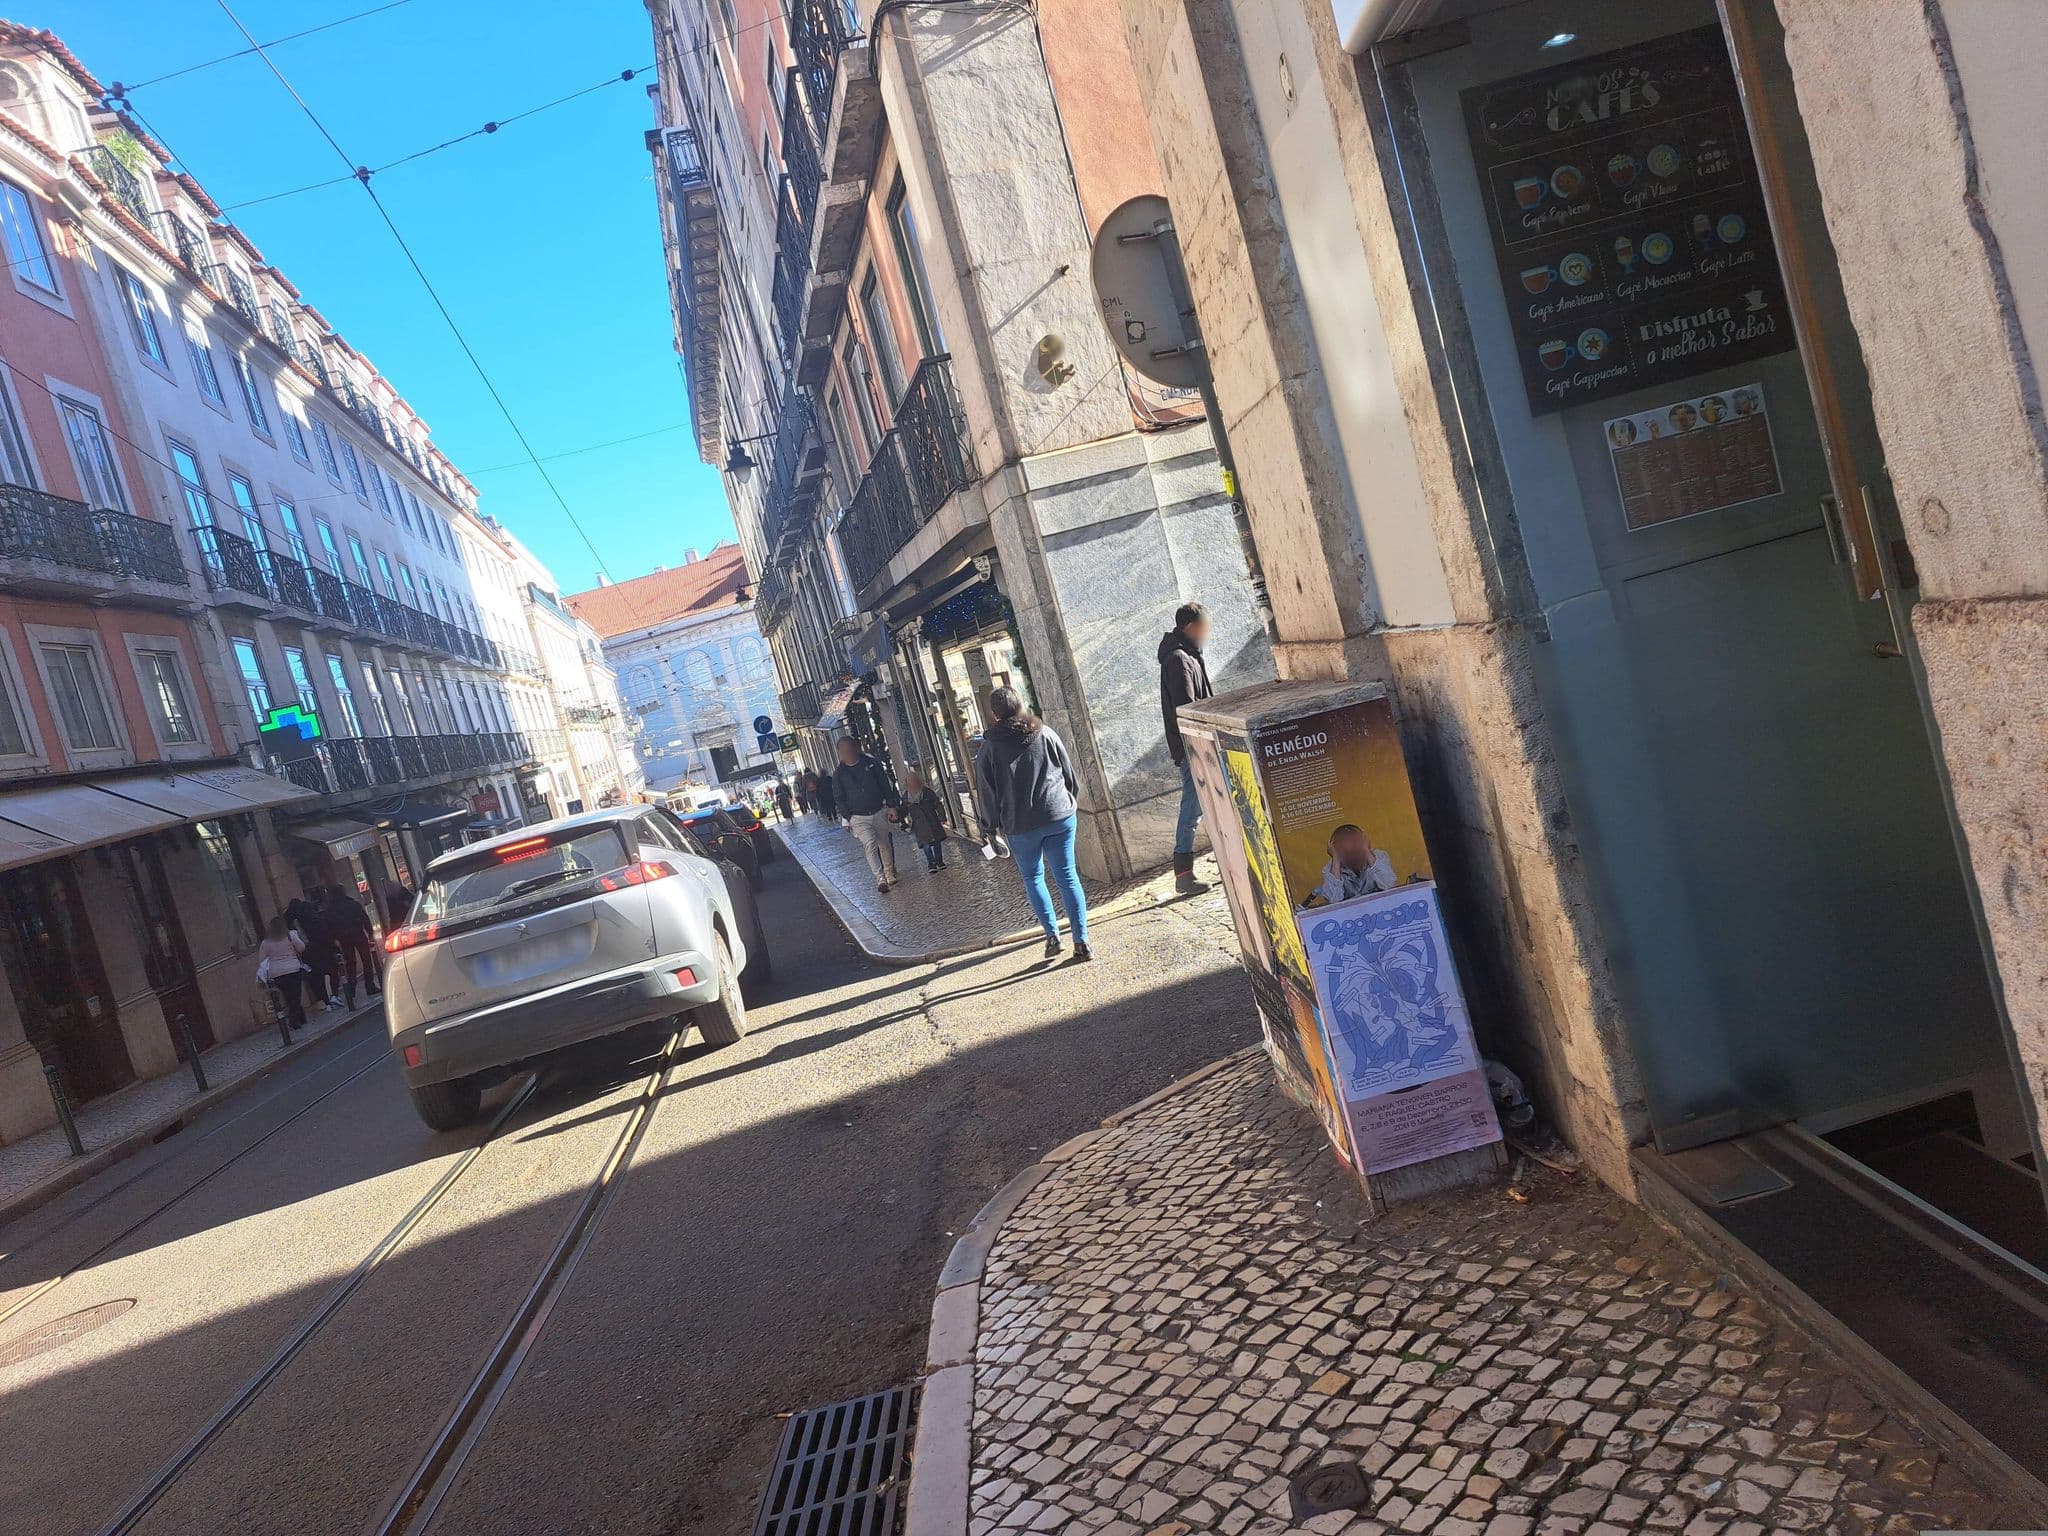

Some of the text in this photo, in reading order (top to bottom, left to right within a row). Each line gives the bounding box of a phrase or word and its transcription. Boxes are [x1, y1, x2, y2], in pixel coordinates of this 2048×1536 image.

[1547, 79, 1662, 132] CAFÉS
[1700, 257, 1726, 277] Café
[1617, 279, 1642, 299] Café
[1102, 297, 1123, 308] CML
[1529, 290, 1604, 322] Café Americano
[1639, 306, 1732, 342] Disfruta
[1647, 311, 1777, 365] o melhor Sabor
[1546, 363, 1628, 395] Café Cappuccino
[1265, 732, 1328, 758] REMÉDIO
[1297, 796, 1331, 810] NOVEMBRO
[1304, 802, 1336, 815] DEZEMBRO
[1358, 1103, 1395, 1117] MARIANA
[1385, 1105, 1417, 1119] RAQUEL
[1418, 1095, 1451, 1110] CASTRO
